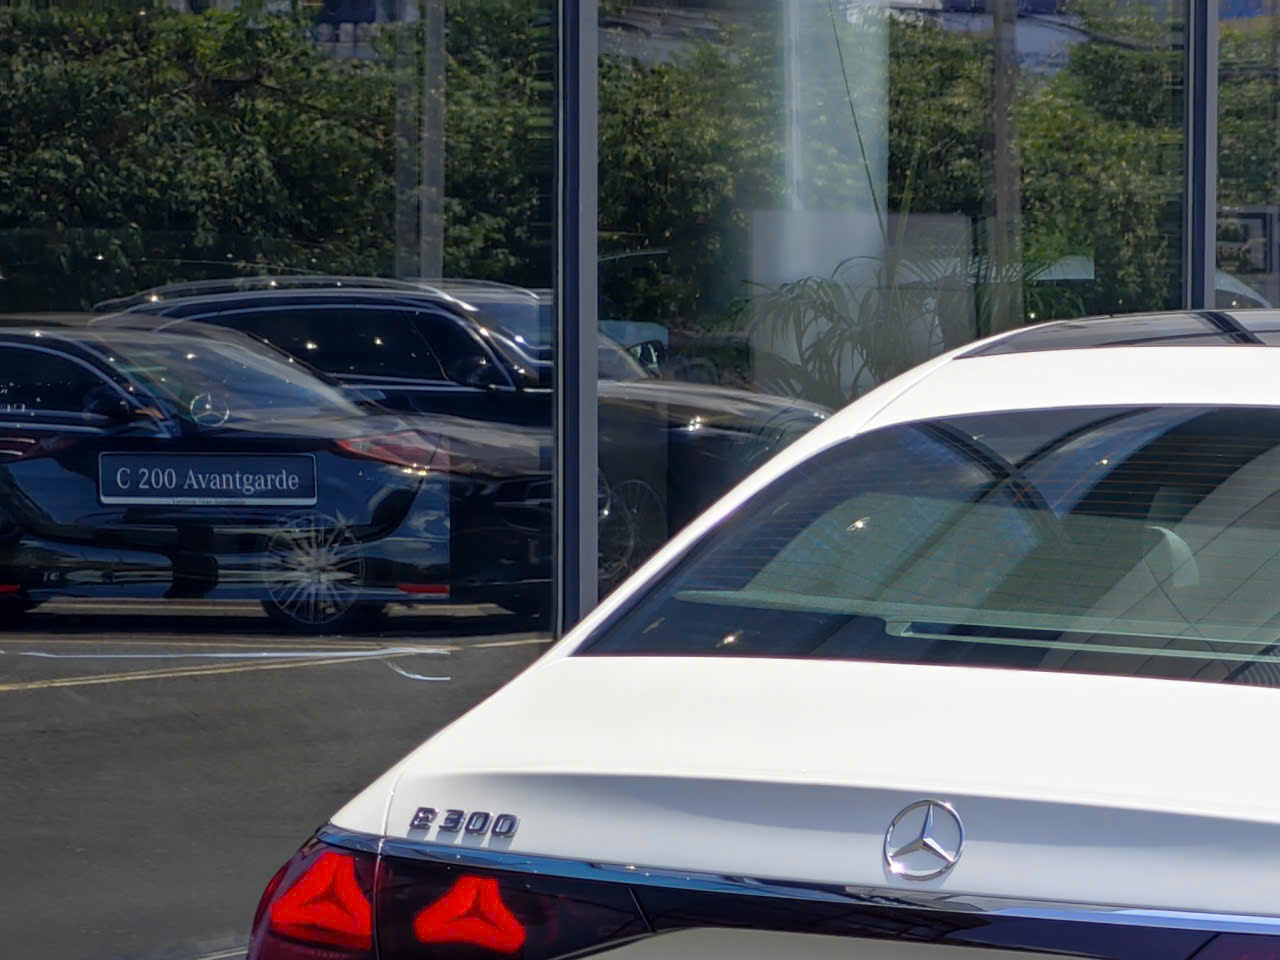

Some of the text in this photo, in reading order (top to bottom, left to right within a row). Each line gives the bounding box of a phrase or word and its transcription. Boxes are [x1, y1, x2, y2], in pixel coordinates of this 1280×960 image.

[116, 467, 299, 494] C 200 Avantgarde
[410, 806, 520, 838] E 300
